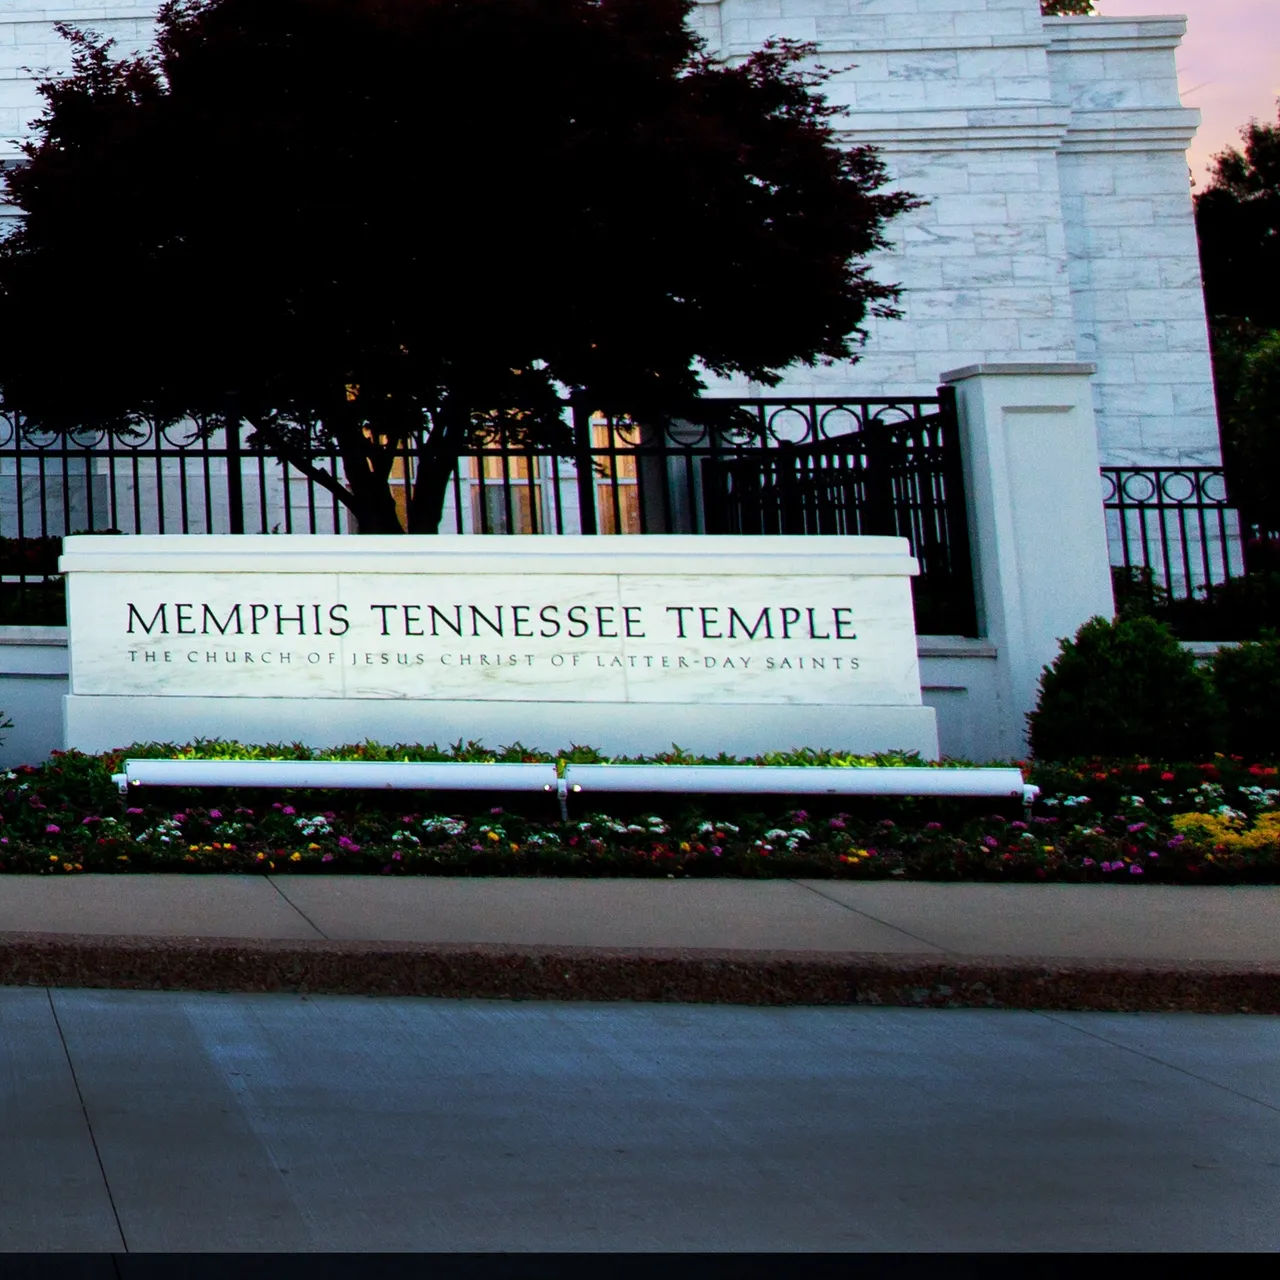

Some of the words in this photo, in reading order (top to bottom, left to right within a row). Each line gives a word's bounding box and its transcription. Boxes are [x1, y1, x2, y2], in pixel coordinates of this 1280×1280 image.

[125, 602, 351, 637] MEMPHIS
[370, 604, 647, 639] TENNESSEE
[666, 606, 858, 640] TEMPLE
[127, 649, 173, 663] THE
[186, 650, 292, 664] CHURCH
[307, 651, 336, 665] OF
[351, 652, 425, 666] JESUS
[440, 652, 535, 667] CHRIST
[550, 654, 582, 668] OF
[596, 654, 752, 670] LATTER-DAY
[765, 656, 861, 670] SAINTS
